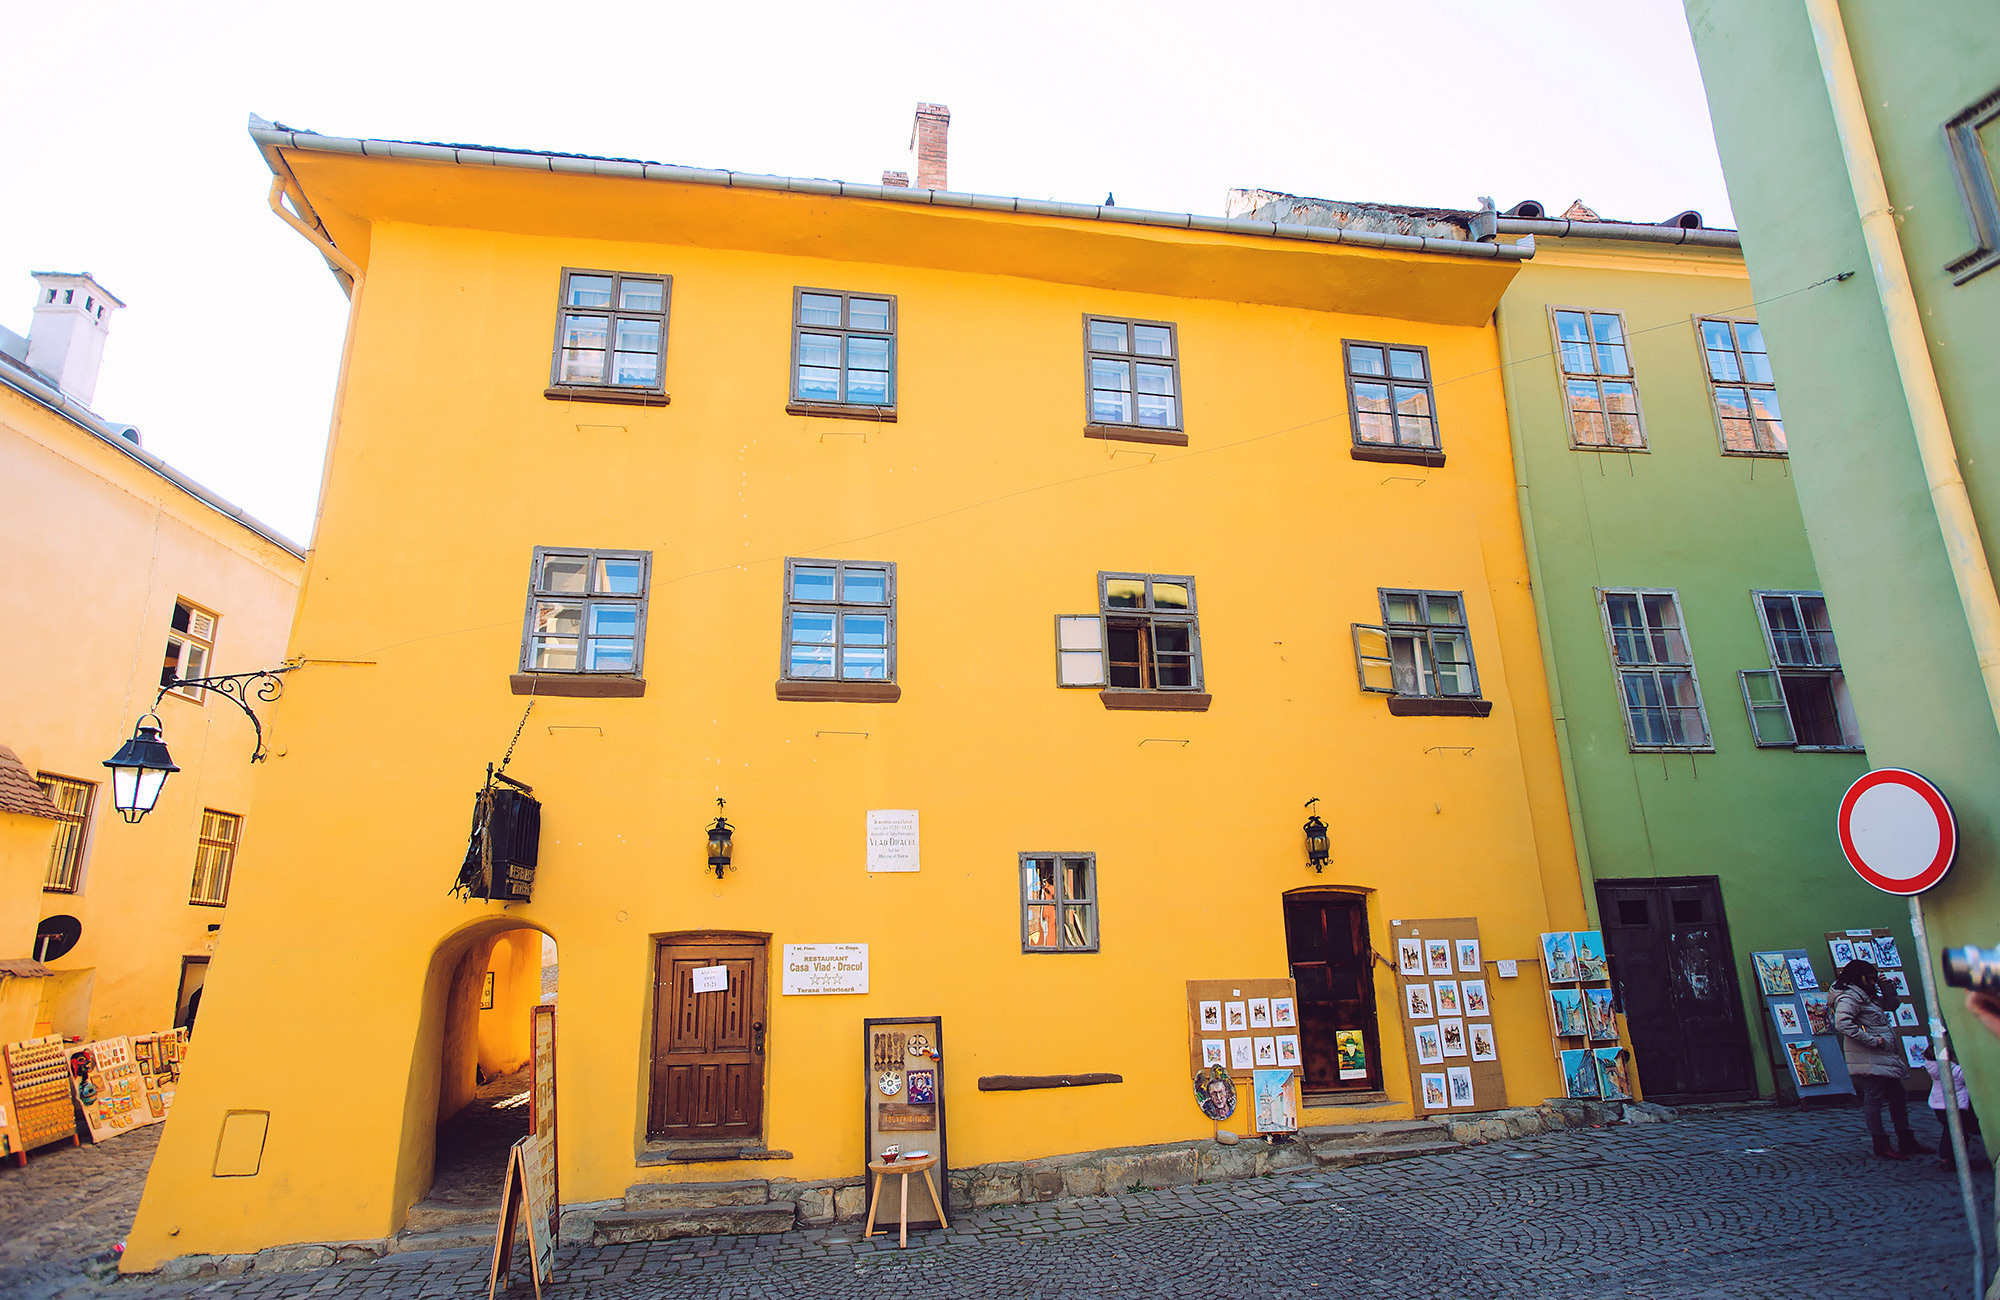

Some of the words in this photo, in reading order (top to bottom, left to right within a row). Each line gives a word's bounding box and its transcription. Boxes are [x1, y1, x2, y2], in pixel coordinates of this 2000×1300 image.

[869, 837, 888, 846] VLAD
[889, 837, 915, 847] DRACUL
[790, 962, 809, 972] Casa
[813, 962, 831, 971] Vlad
[837, 962, 863, 971] Dracul
